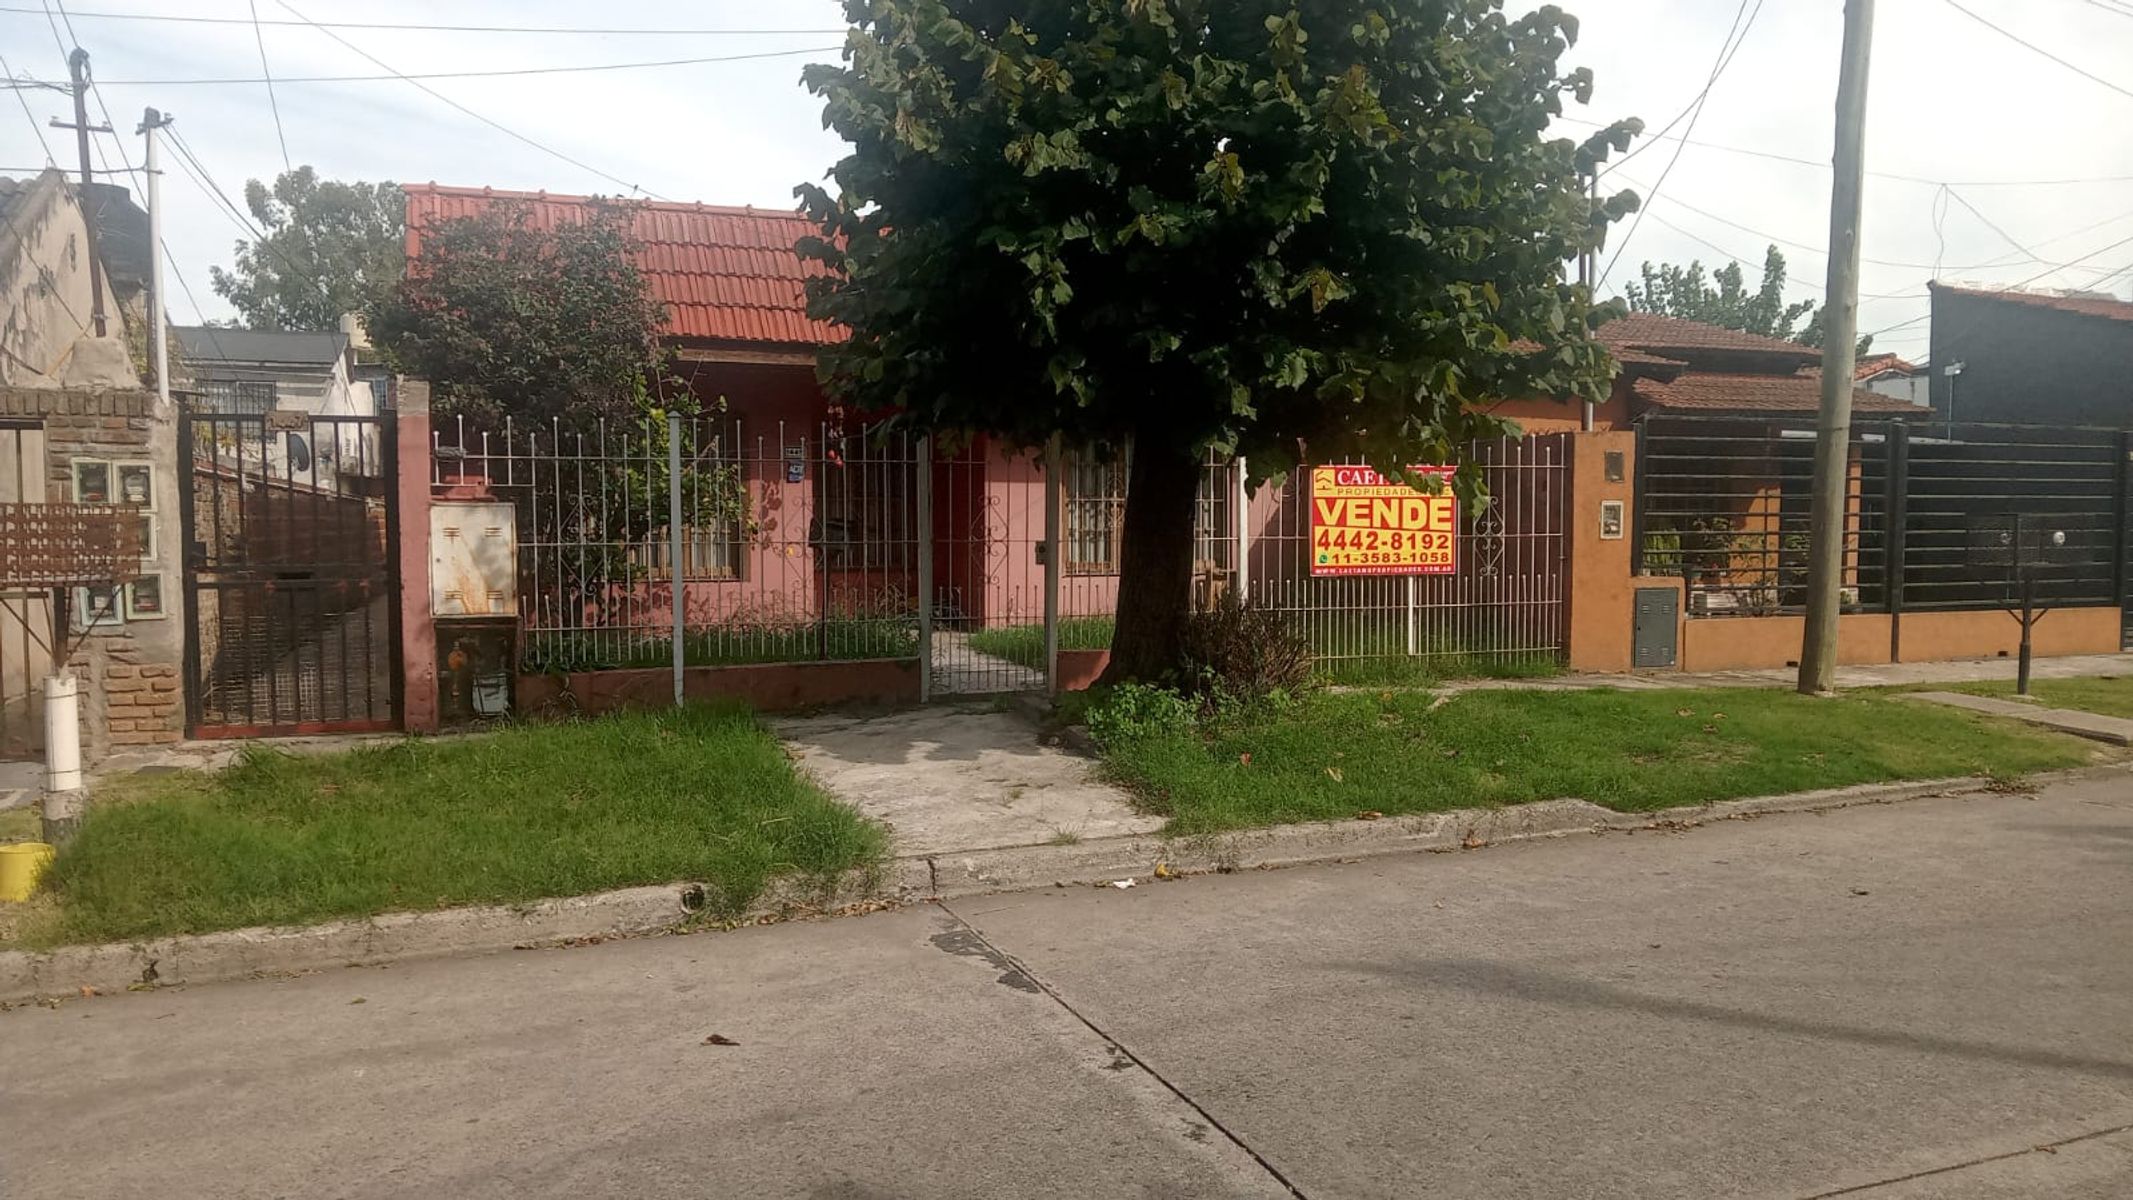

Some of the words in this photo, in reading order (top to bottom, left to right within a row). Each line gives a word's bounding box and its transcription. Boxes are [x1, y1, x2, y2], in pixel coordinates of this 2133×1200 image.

[1315, 498, 1452, 530] VENDE
[1317, 529, 1449, 550] 4442-8192
[1331, 552, 1449, 564] 11-3583-1058
